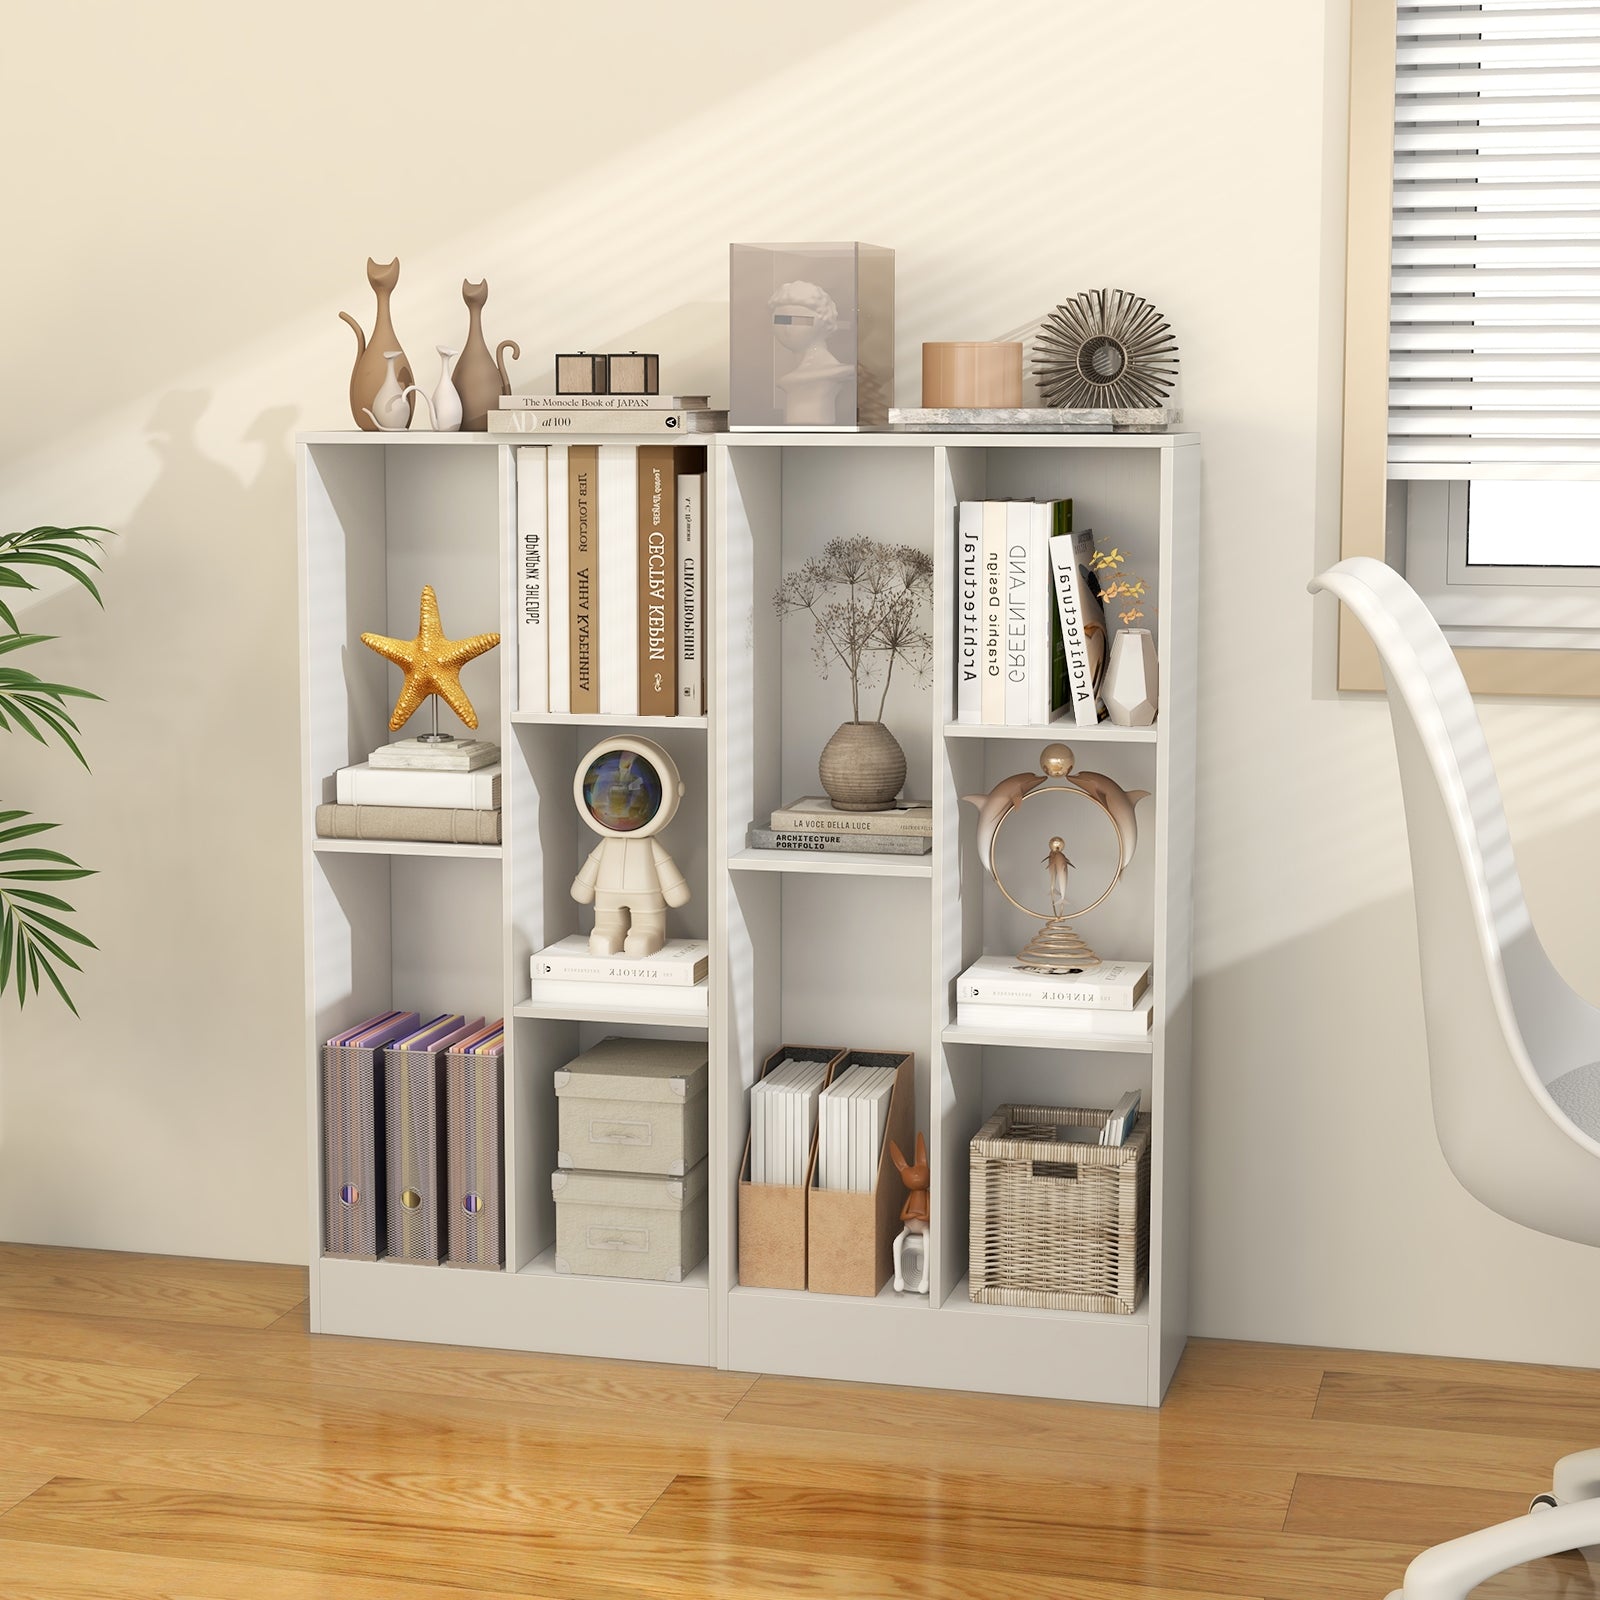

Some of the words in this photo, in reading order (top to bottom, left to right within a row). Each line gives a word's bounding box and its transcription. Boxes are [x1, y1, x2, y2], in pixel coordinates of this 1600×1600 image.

[522, 398, 540, 407] The
[542, 398, 579, 407] Monocle
[581, 398, 603, 407] Book
[604, 398, 615, 407] of
[616, 399, 649, 408] JAPAN
[506, 412, 537, 432] AD
[541, 417, 553, 427] at
[553, 417, 571, 427] 100
[793, 819, 804, 828] LA
[804, 820, 826, 829] VOCE
[827, 821, 850, 829] DELLA
[852, 822, 871, 830] LUCE
[776, 834, 841, 843] ARCHITECTURE
[776, 842, 825, 850] PORTFOLIO
